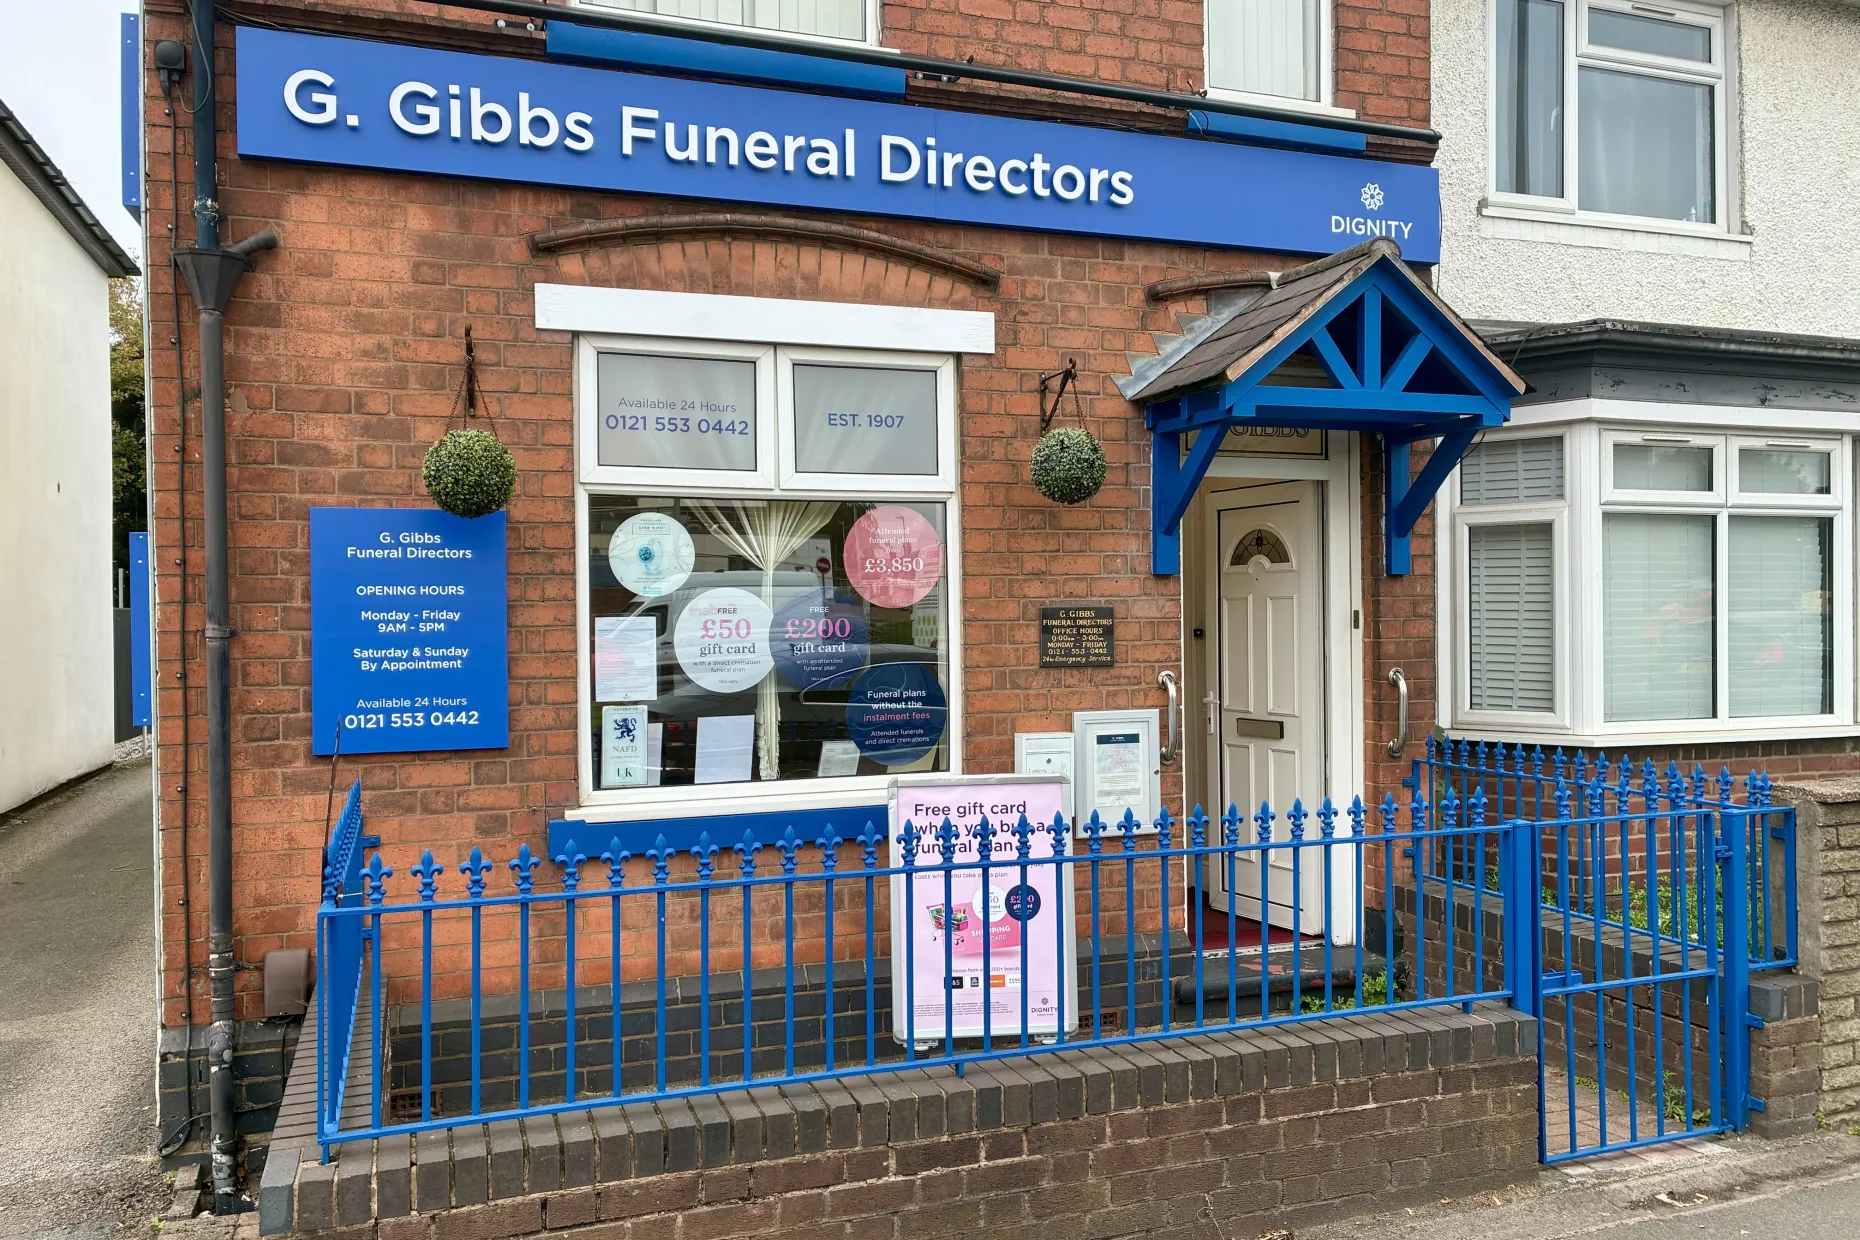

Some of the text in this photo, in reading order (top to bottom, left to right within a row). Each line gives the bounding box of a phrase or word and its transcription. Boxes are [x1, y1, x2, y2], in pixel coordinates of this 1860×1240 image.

[283, 68, 1135, 206] G. Gibbs Funeral Directors
[1331, 215, 1413, 239] DIGNITY
[618, 397, 737, 413] Available 24 Hours
[605, 414, 750, 436] 0121 553 0442
[828, 413, 905, 428] EST. 1907
[380, 532, 442, 544] G. Gibbs
[897, 536, 917, 545] plans
[347, 547, 472, 559] Funeral Directors
[864, 558, 924, 574] £3,850
[356, 585, 465, 596] OPENING HOURS
[361, 610, 410, 622] Monday
[422, 610, 460, 622] Friday
[378, 623, 407, 633] 9AM
[418, 623, 446, 632] 5PM
[700, 618, 752, 640] £50
[784, 618, 851, 639] £200
[353, 647, 470, 659] Saturday & Sunday
[700, 642, 756, 658] gift card
[793, 642, 846, 656] gift card
[361, 660, 462, 672] By Appointment
[867, 690, 926, 698] Funeral plans
[356, 697, 468, 709] Available 24 Hours
[872, 700, 922, 710] without the
[344, 711, 480, 728] 0121 553 0442
[864, 712, 931, 722] instalment fees
[617, 767, 633, 778] UK
[914, 800, 1026, 818] Free gift card
[1036, 822, 1045, 832] a
[914, 840, 972, 854] funral
[914, 872, 930, 880] costs
